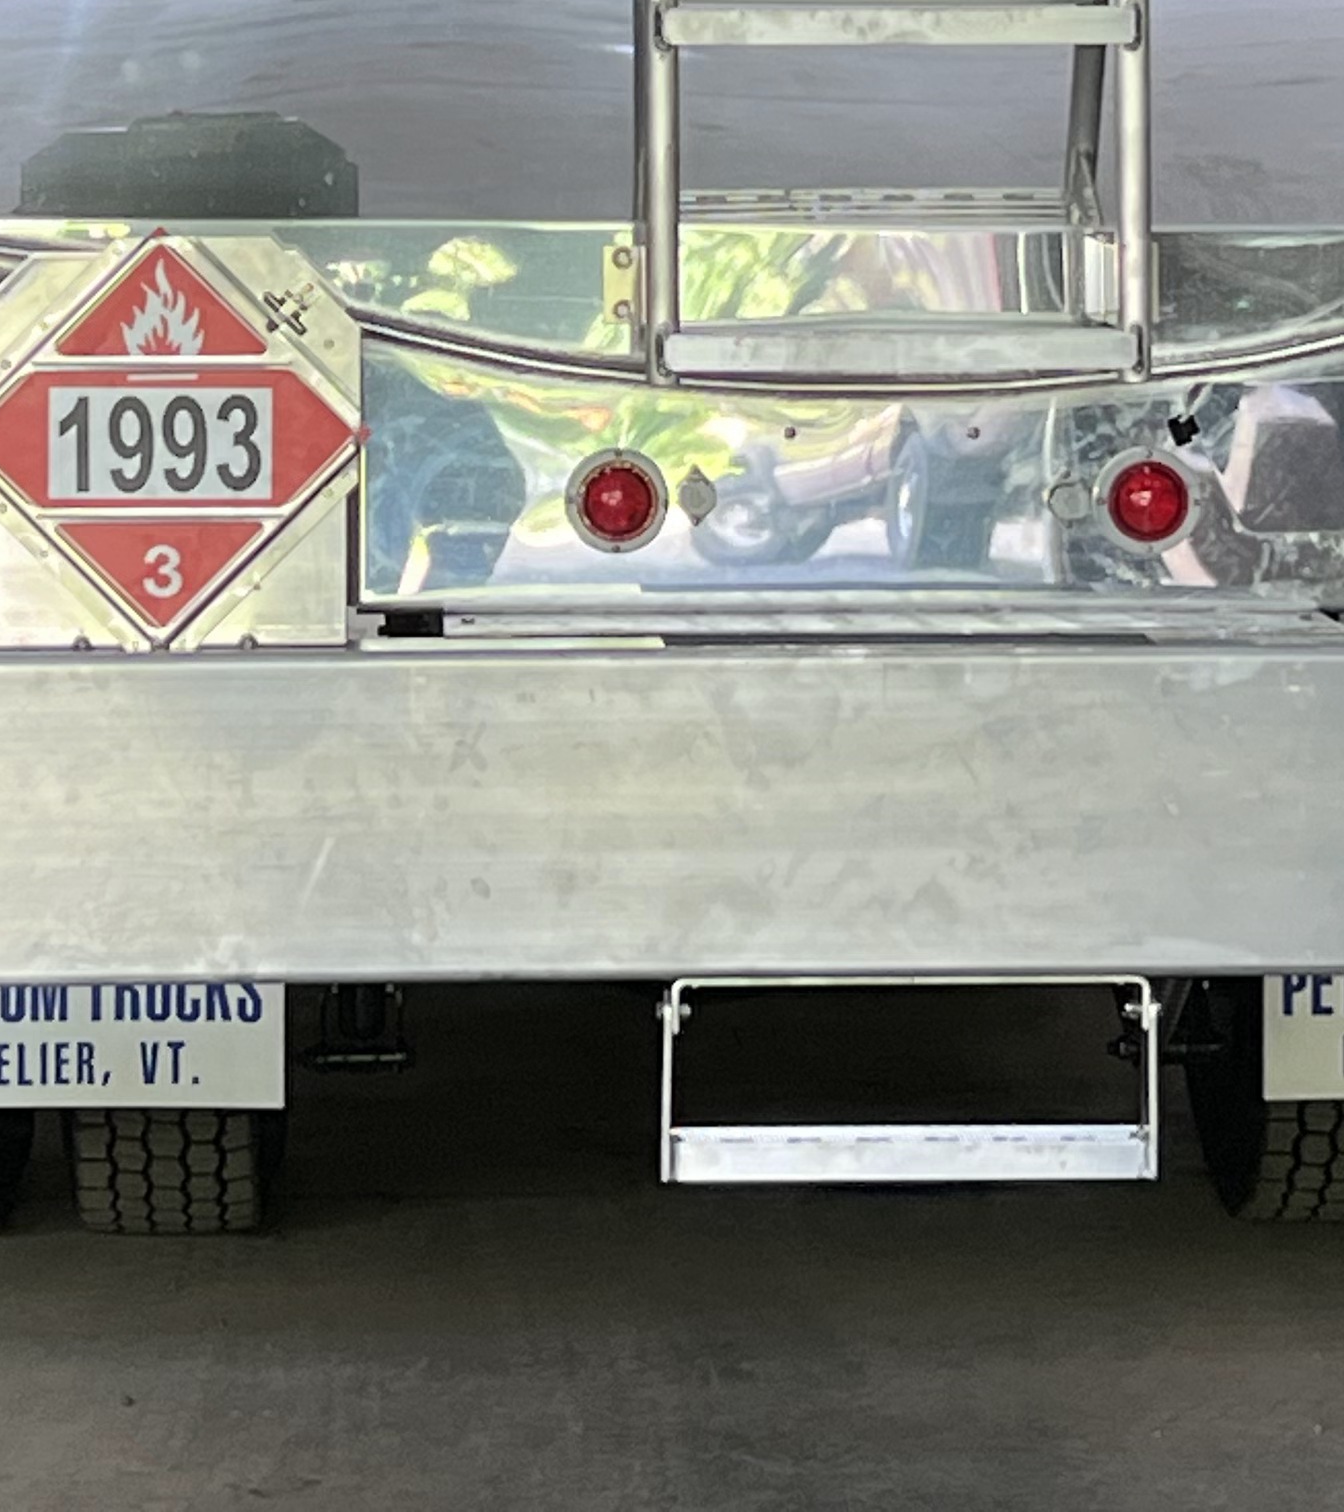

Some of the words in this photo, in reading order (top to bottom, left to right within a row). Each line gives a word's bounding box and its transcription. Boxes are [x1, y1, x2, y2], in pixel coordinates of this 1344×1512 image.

[58, 394, 262, 493] 1993
[142, 543, 183, 599] 3
[140, 1040, 200, 1085] VT.
